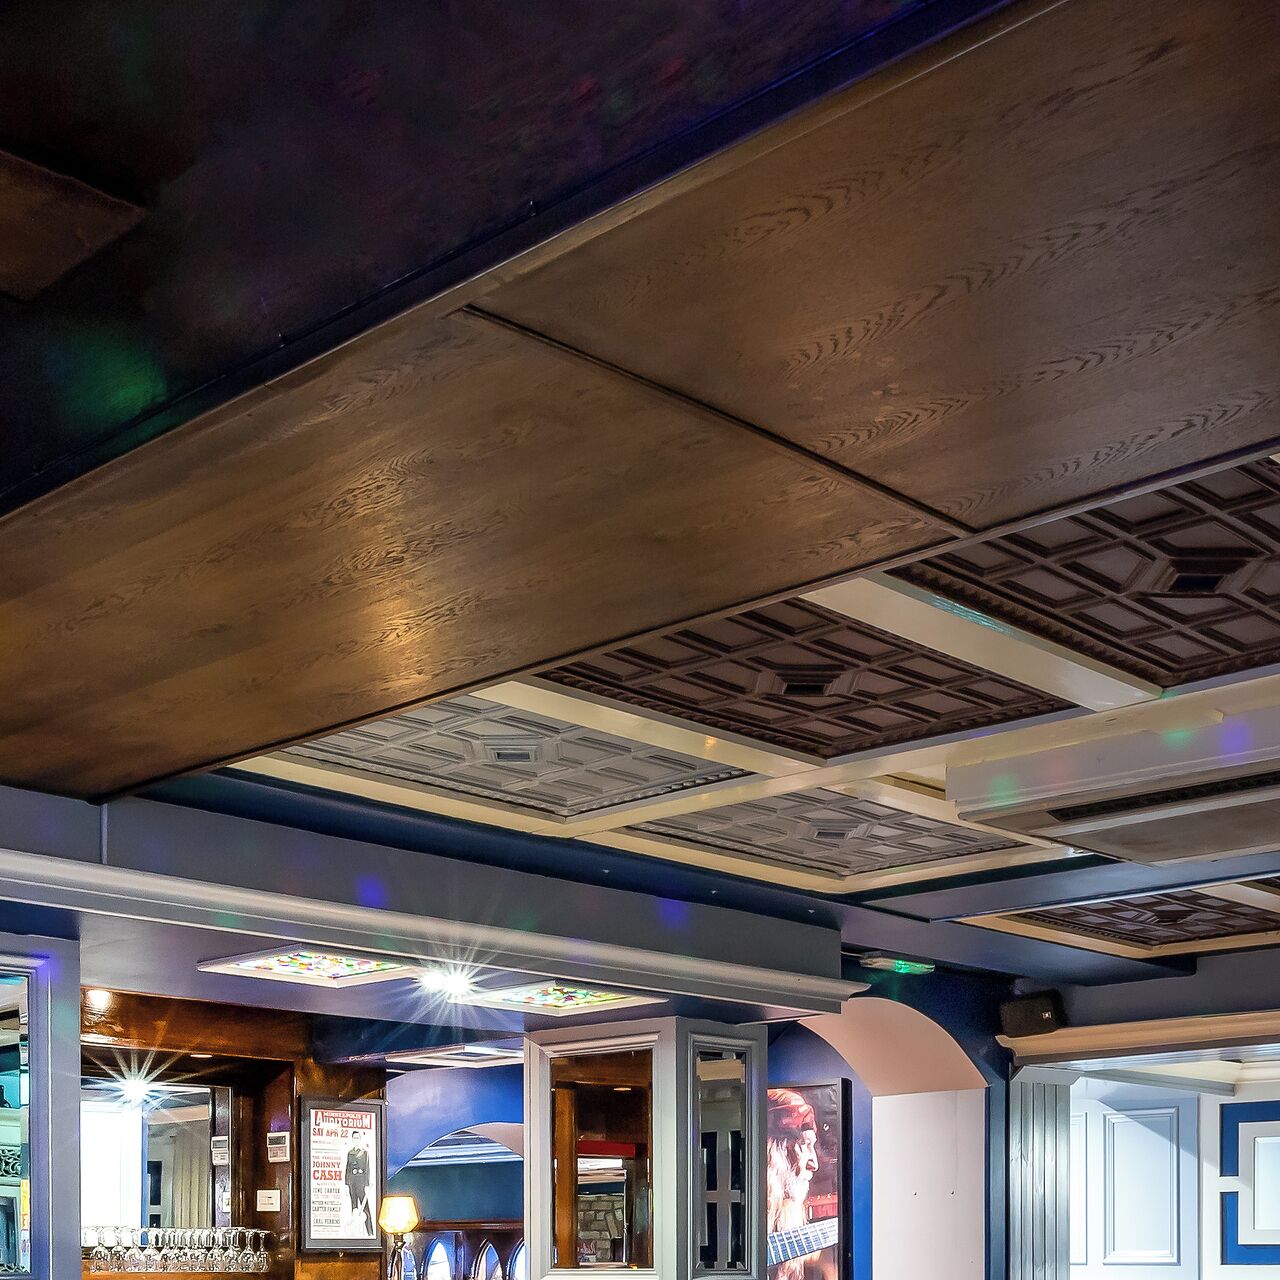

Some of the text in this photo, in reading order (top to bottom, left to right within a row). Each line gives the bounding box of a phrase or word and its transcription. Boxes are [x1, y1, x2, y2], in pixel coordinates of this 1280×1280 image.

[315, 1111, 371, 1129] AUDITORIUM
[312, 1128, 349, 1138] SAT APR 22
[312, 1161, 341, 1169] JOHNNY
[313, 1169, 343, 1181] CASH
